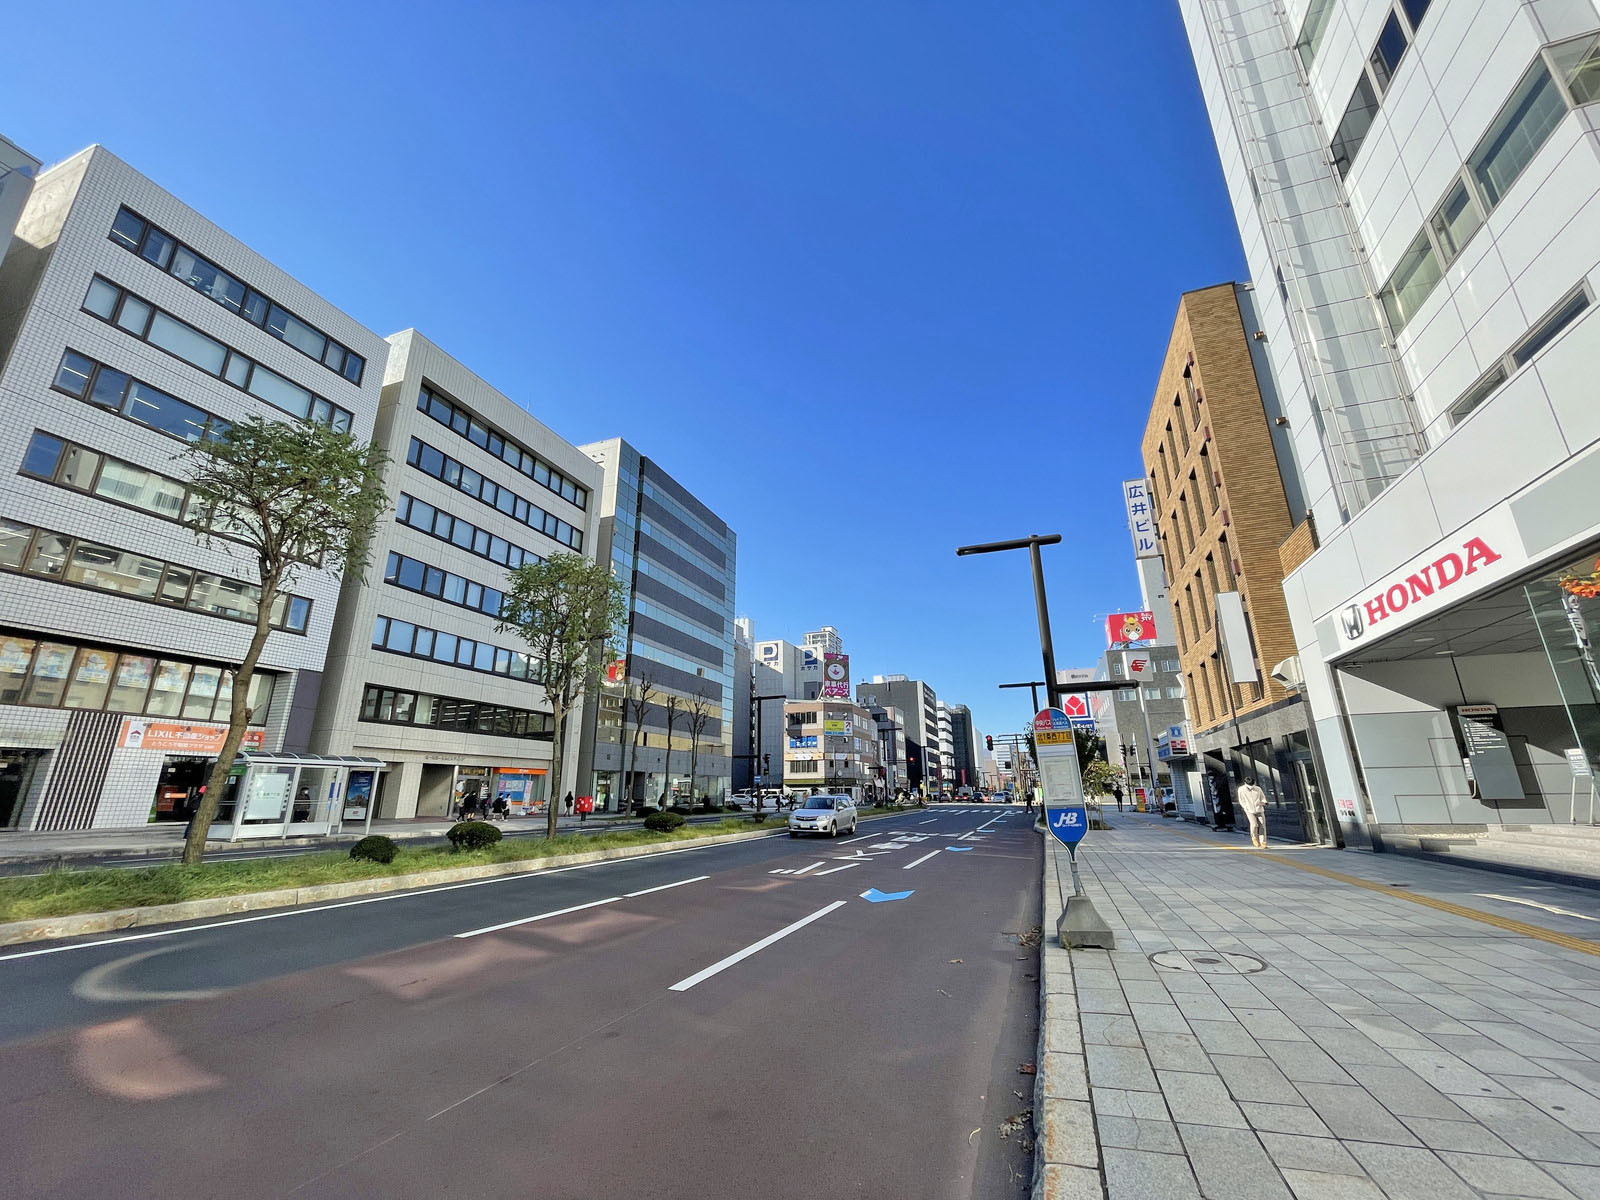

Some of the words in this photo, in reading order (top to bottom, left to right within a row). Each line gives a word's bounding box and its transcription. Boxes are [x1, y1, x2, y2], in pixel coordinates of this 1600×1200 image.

[1128, 485, 1154, 551] 広井ビル
[1363, 536, 1502, 626] HONDA
